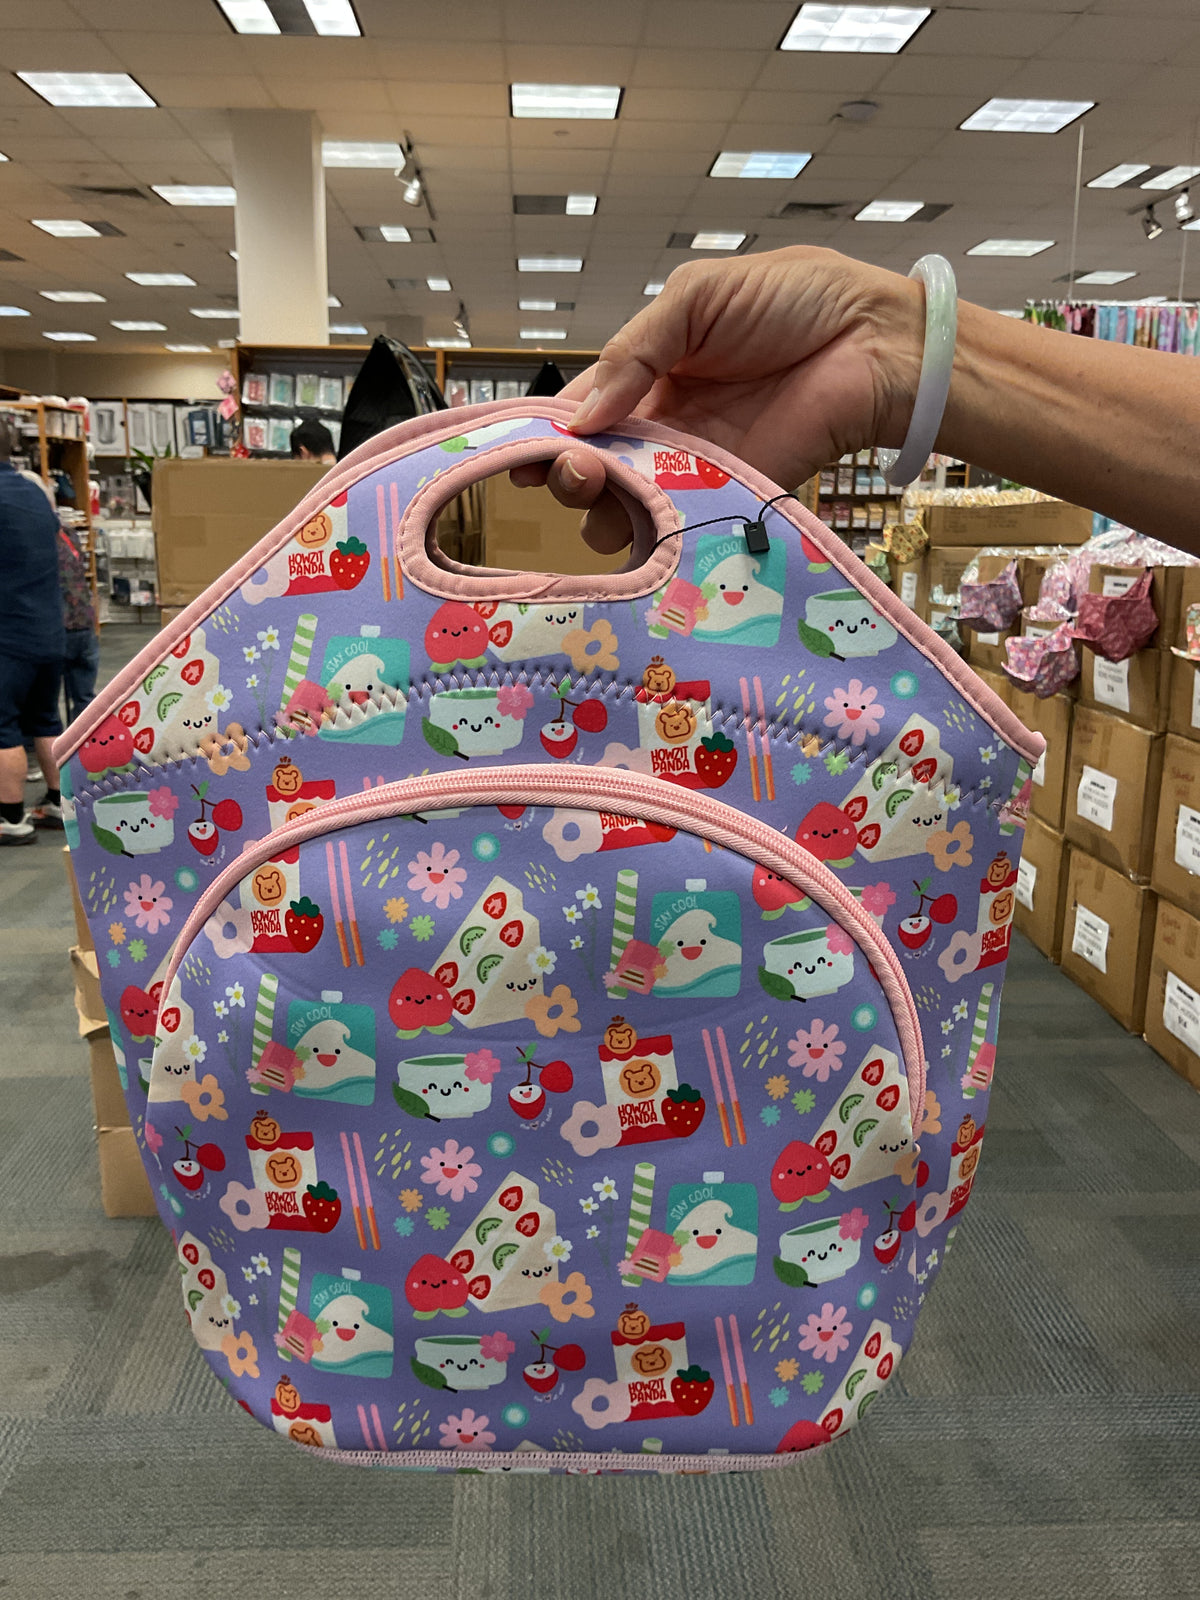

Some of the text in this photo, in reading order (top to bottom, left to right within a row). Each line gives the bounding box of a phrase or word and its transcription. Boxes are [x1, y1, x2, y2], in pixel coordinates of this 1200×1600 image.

[654, 460, 691, 472] PANDA
[288, 550, 324, 565] HOWZIT
[289, 562, 325, 576] PANDA
[326, 652, 344, 673] STAY
[650, 746, 689, 762] HOWZIT
[652, 758, 690, 773] PANDA
[671, 895, 698, 913] COOL
[250, 909, 280, 922] HOWZIT
[252, 919, 282, 934] PANDA
[306, 1006, 333, 1022] COOL
[617, 1099, 655, 1116] HOWZIT
[620, 1111, 658, 1127] PANDA
[688, 1186, 715, 1203] COOL
[628, 1377, 665, 1393] HOWZIT
[629, 1389, 667, 1403] PANDA
